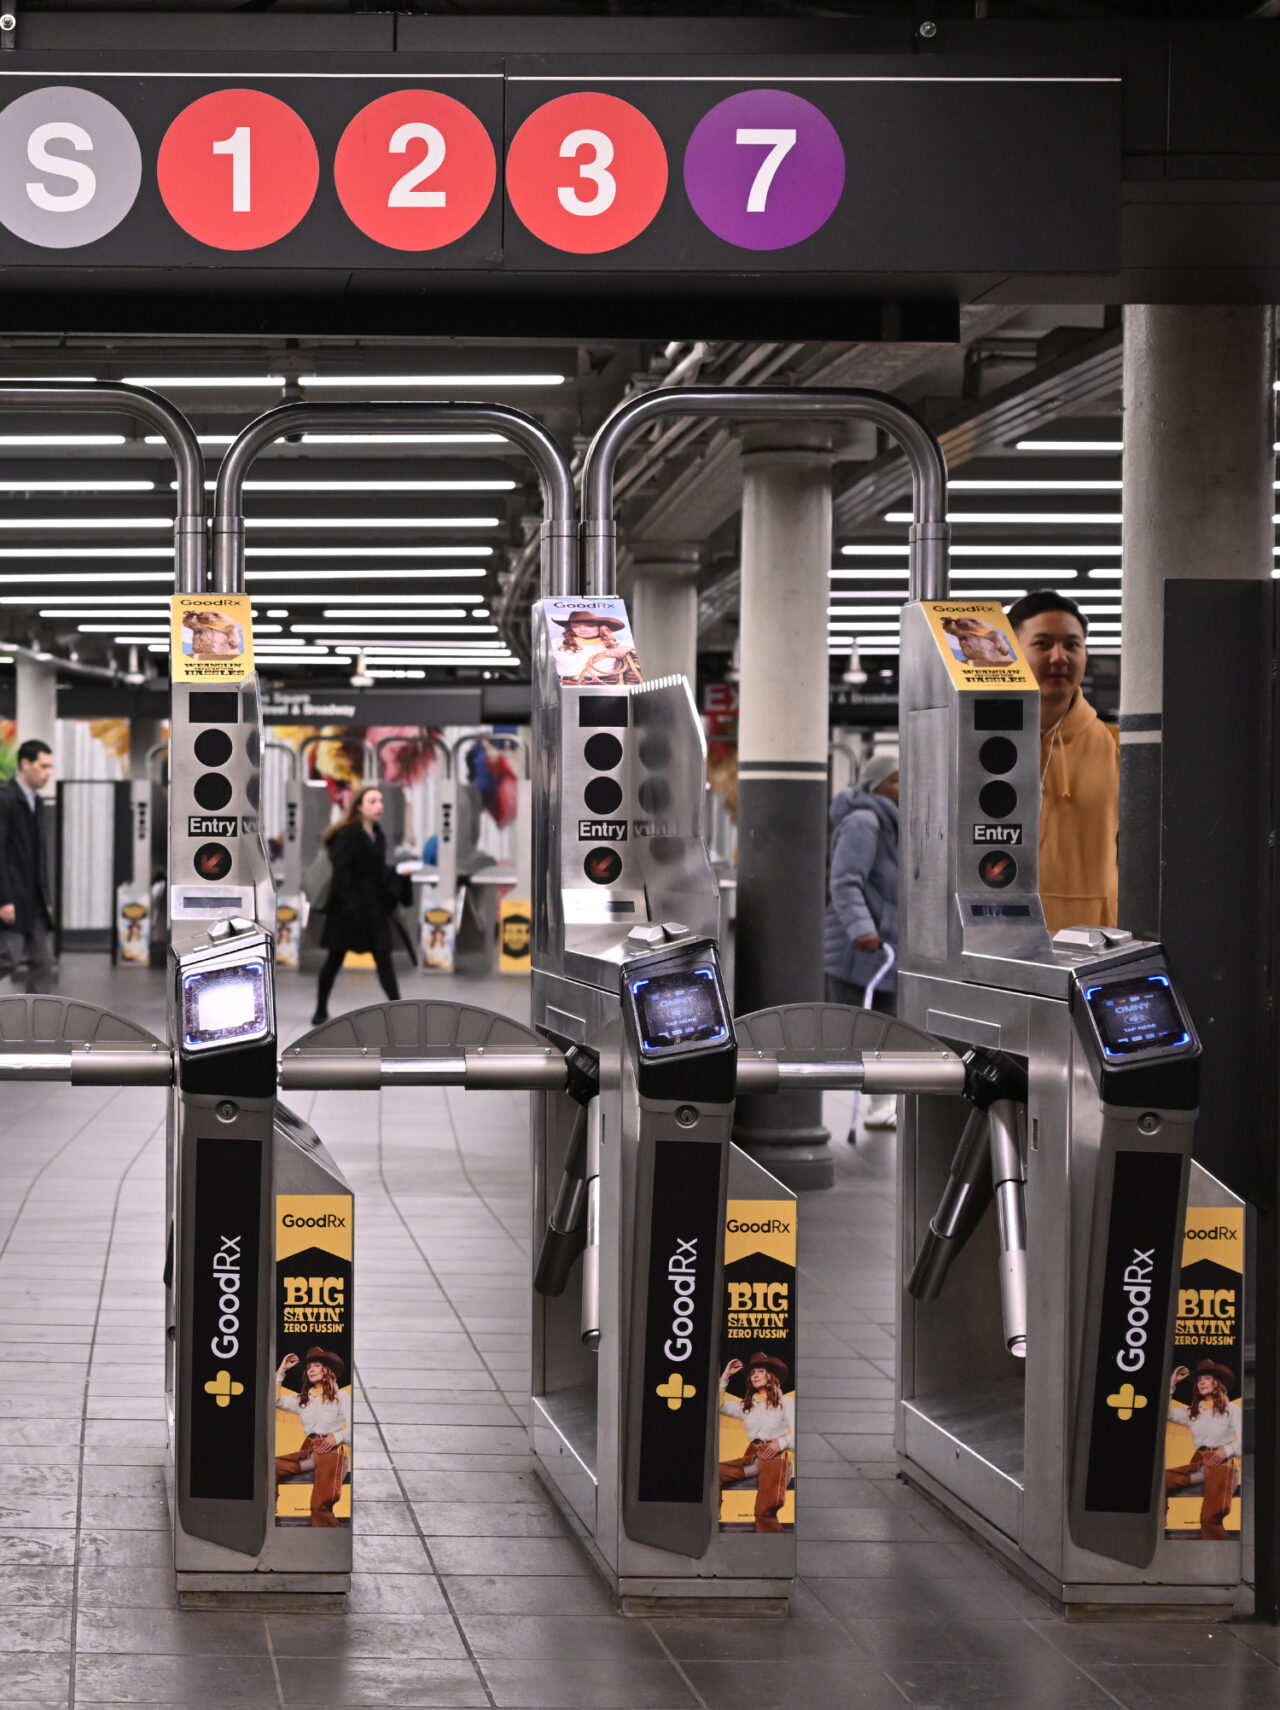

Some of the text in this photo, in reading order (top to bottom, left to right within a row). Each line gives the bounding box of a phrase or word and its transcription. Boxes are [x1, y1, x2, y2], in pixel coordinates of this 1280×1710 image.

[25, 121, 97, 212] S
[212, 126, 251, 212] 1
[387, 122, 447, 208] 2
[557, 128, 617, 217] 3
[736, 128, 797, 212] 7
[190, 818, 236, 836] Entry
[580, 822, 626, 840] Entry
[974, 825, 1021, 844] Entry
[1114, 1002, 1150, 1014] OMNY
[282, 1213, 346, 1228] GoodRx
[726, 1219, 790, 1233] GoodRx
[1184, 1226, 1237, 1240] oodRx
[211, 1234, 241, 1359] GoodRx
[283, 1276, 344, 1306] BIG
[727, 1282, 788, 1311] BIG
[663, 1237, 698, 1362] GoodRx
[1176, 1288, 1236, 1318] BIG
[283, 1307, 344, 1322] SAVIN'
[1115, 1247, 1156, 1373] GoodRx
[727, 1312, 788, 1327] SAVIN'
[1175, 1320, 1235, 1334] SAVIN'
[283, 1323, 345, 1333] ZERO FUSSIN'
[727, 1328, 789, 1339] ZERO FUSSIN'
[1174, 1335, 1236, 1346] ZERO FUSSIN'
